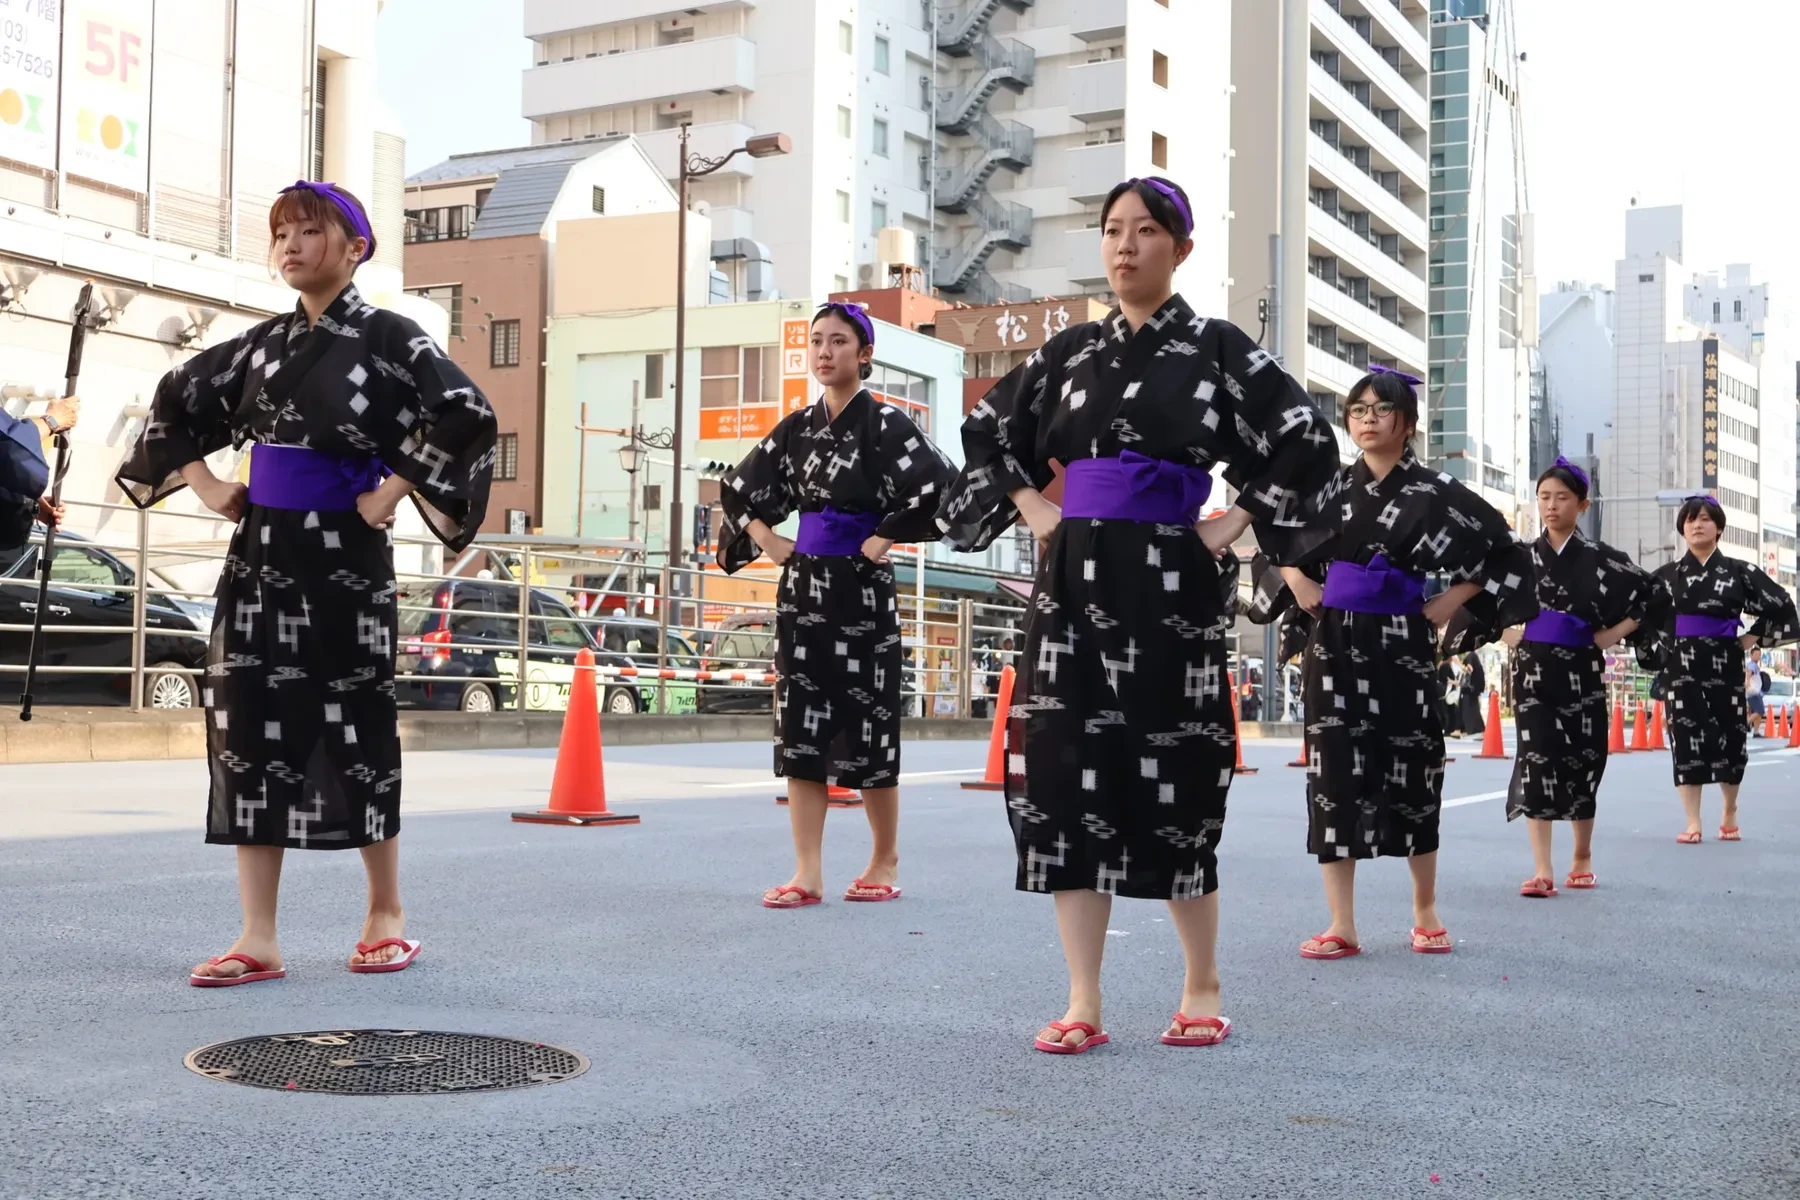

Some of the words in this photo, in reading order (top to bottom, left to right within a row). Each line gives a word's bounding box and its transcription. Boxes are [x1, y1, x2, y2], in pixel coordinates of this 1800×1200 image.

[0, 45, 53, 79] 5-7526
[85, 20, 142, 82] 5F
[77, 106, 140, 158] ROX
[676, 696, 697, 705] フルク
